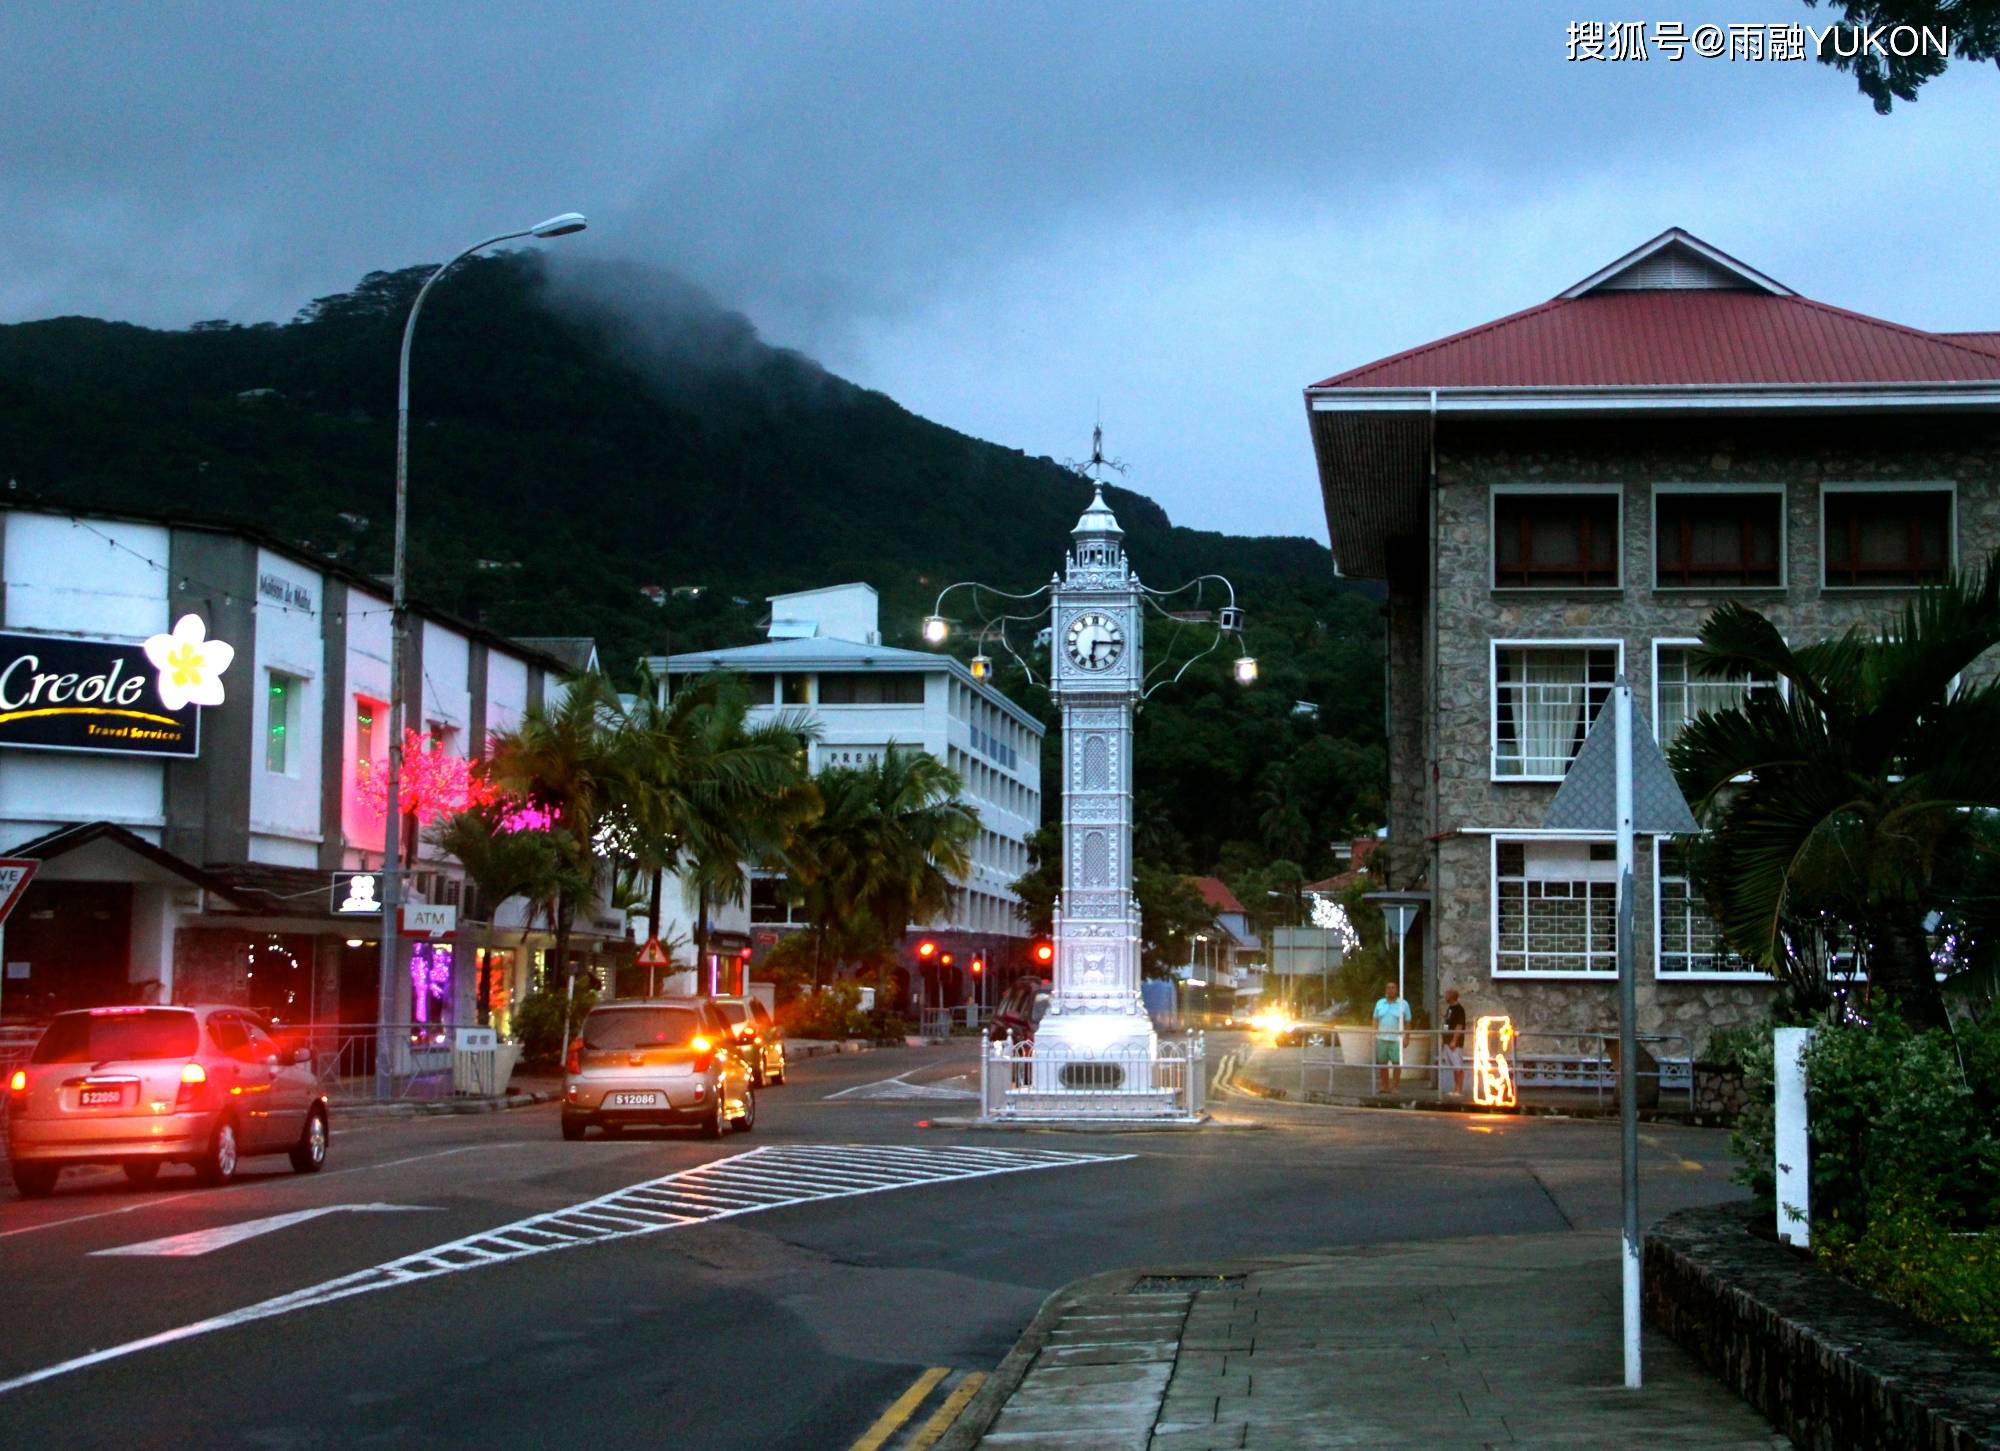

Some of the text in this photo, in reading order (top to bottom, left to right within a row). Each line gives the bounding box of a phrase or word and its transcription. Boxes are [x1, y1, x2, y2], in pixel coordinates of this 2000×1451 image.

[0, 655, 145, 710] Creole
[88, 724, 181, 740] Travel Services
[831, 752, 880, 764] PREM
[416, 912, 445, 925] ATM
[616, 1094, 655, 1104] S12086
